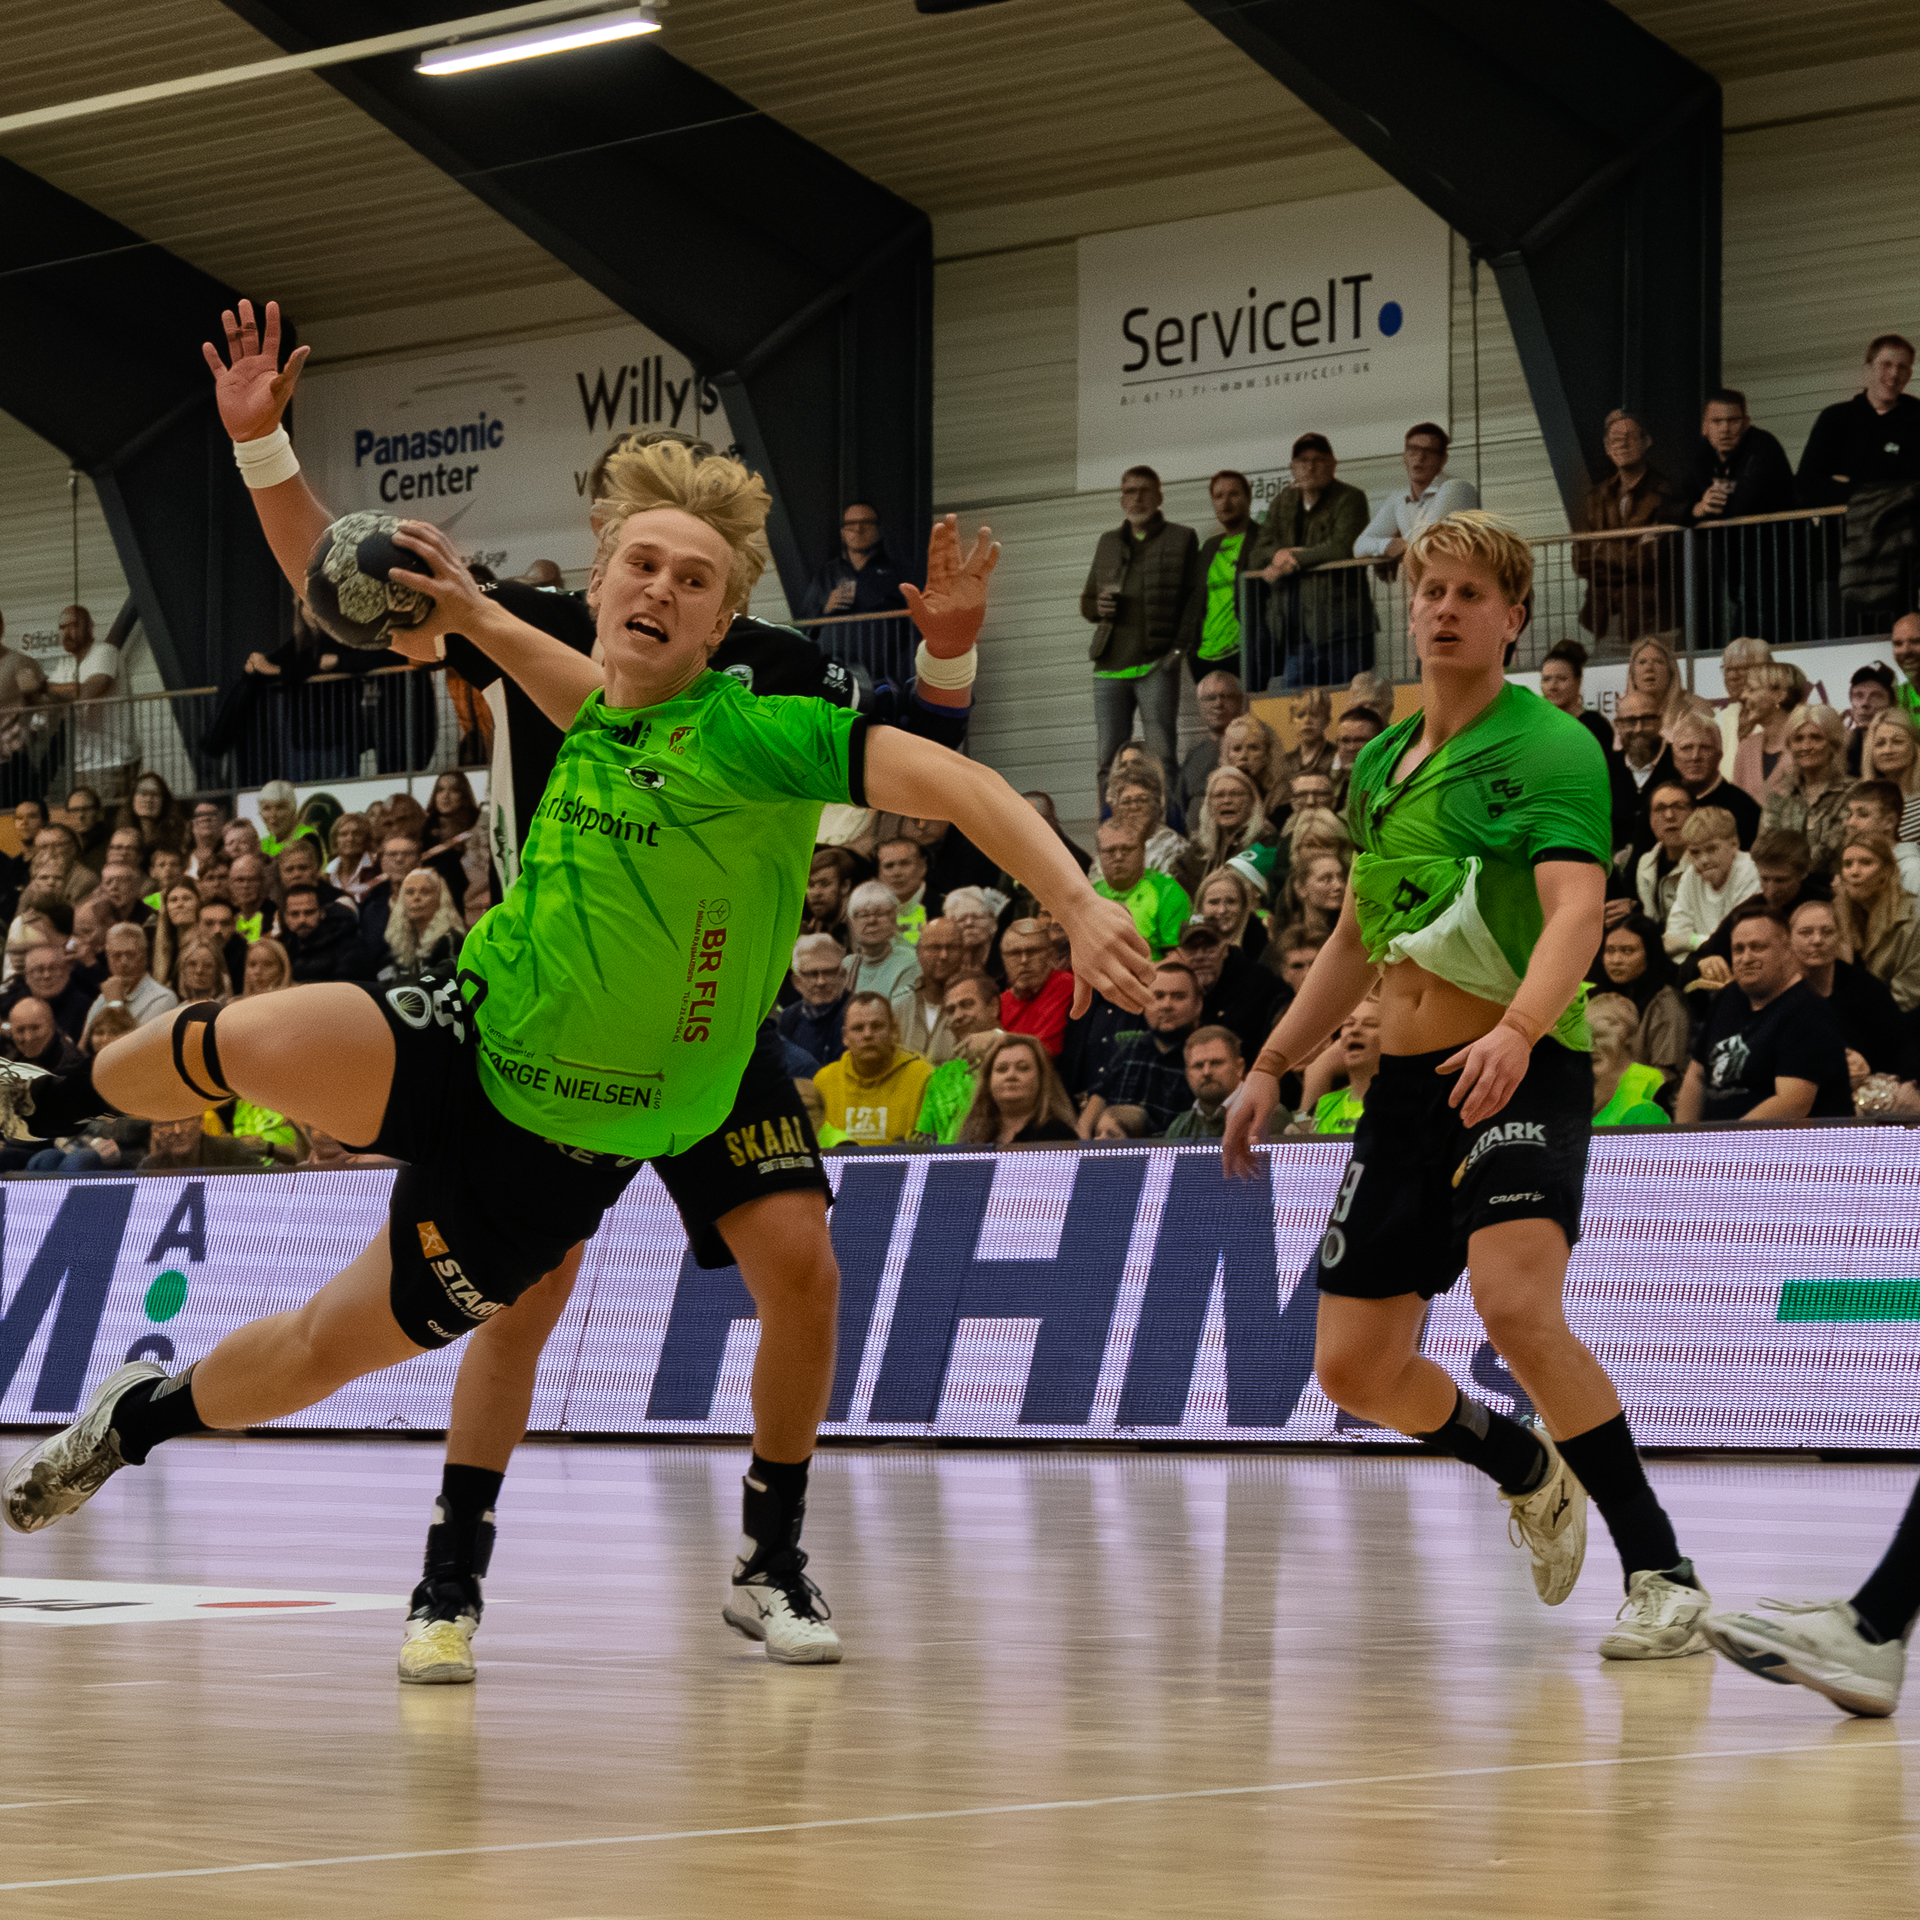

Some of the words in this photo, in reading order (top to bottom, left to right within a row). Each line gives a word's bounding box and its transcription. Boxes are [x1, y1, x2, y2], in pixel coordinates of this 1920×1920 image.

[576, 355, 719, 434] Willys
[355, 411, 504, 467] Panasonic
[379, 463, 479, 503] Center
[546, 790, 660, 847] riskpoint
[697, 928, 727, 973] BR
[682, 980, 718, 1043] FLIS
[554, 1075, 652, 1109] NIELSEN
[725, 1116, 811, 1167] SKAAL
[1468, 1122, 1547, 1165] STARK
